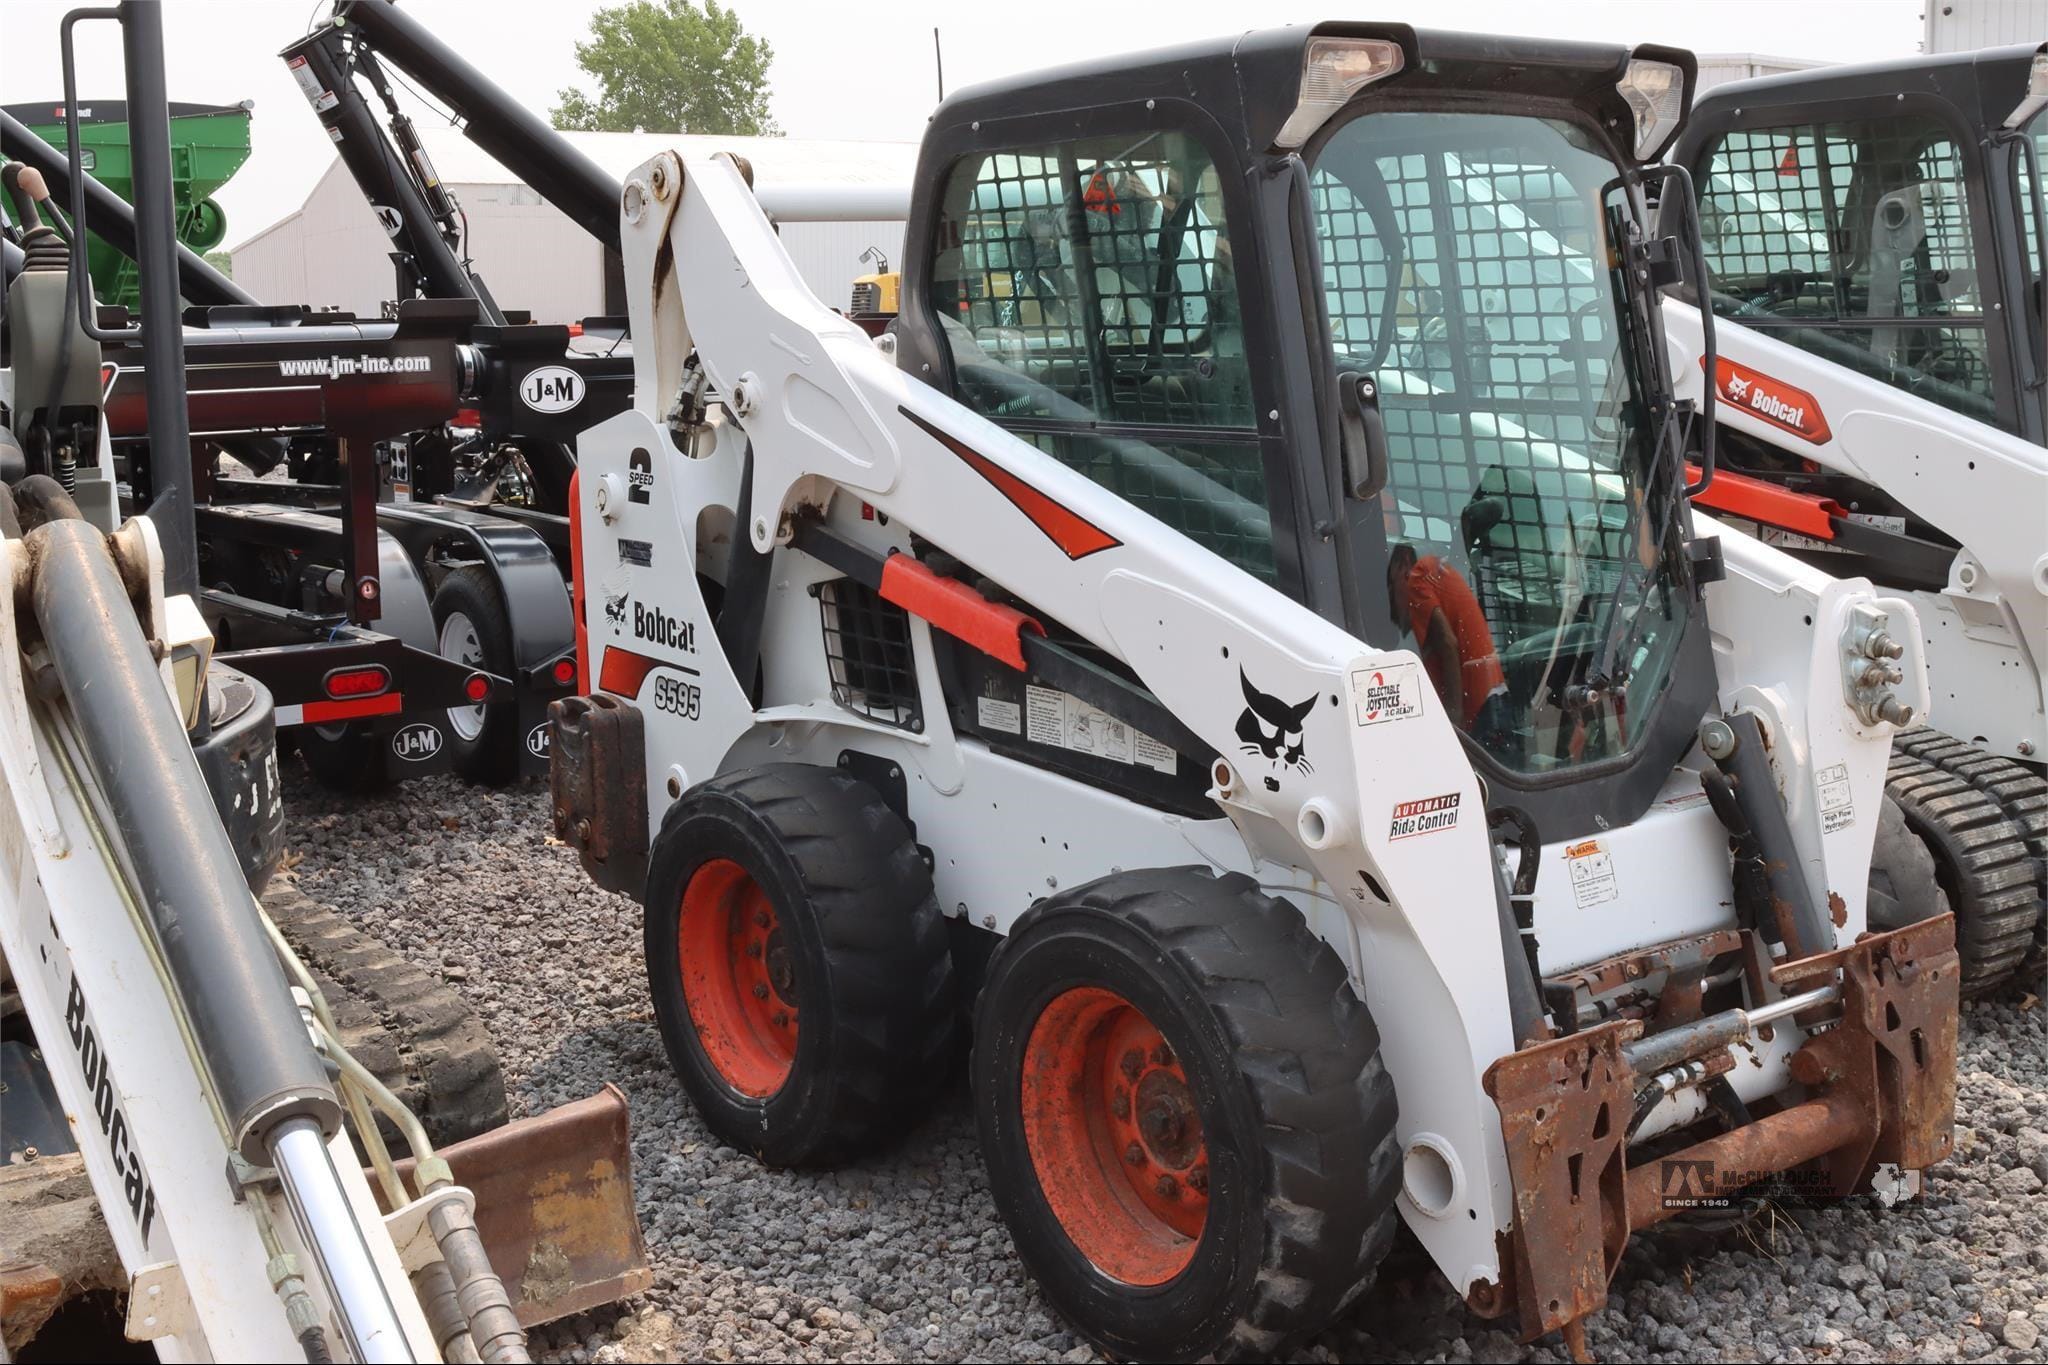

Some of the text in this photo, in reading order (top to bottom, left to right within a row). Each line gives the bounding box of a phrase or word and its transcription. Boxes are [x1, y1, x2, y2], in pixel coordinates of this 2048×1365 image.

[279, 354, 431, 380] www.jm-inc.com
[527, 377, 575, 403] J&M
[1751, 387, 1804, 428] Bobcat
[628, 447, 652, 505] 2
[629, 471, 654, 486] SPEED
[634, 601, 696, 654] Bobcat
[655, 675, 700, 721] S595
[1366, 695, 1400, 712] JOYSTICKS
[1367, 684, 1400, 698] SELECTABLE
[396, 729, 436, 755] J&M
[1395, 795, 1458, 818] AUTOMATIC
[1391, 809, 1458, 837] Ride Control
